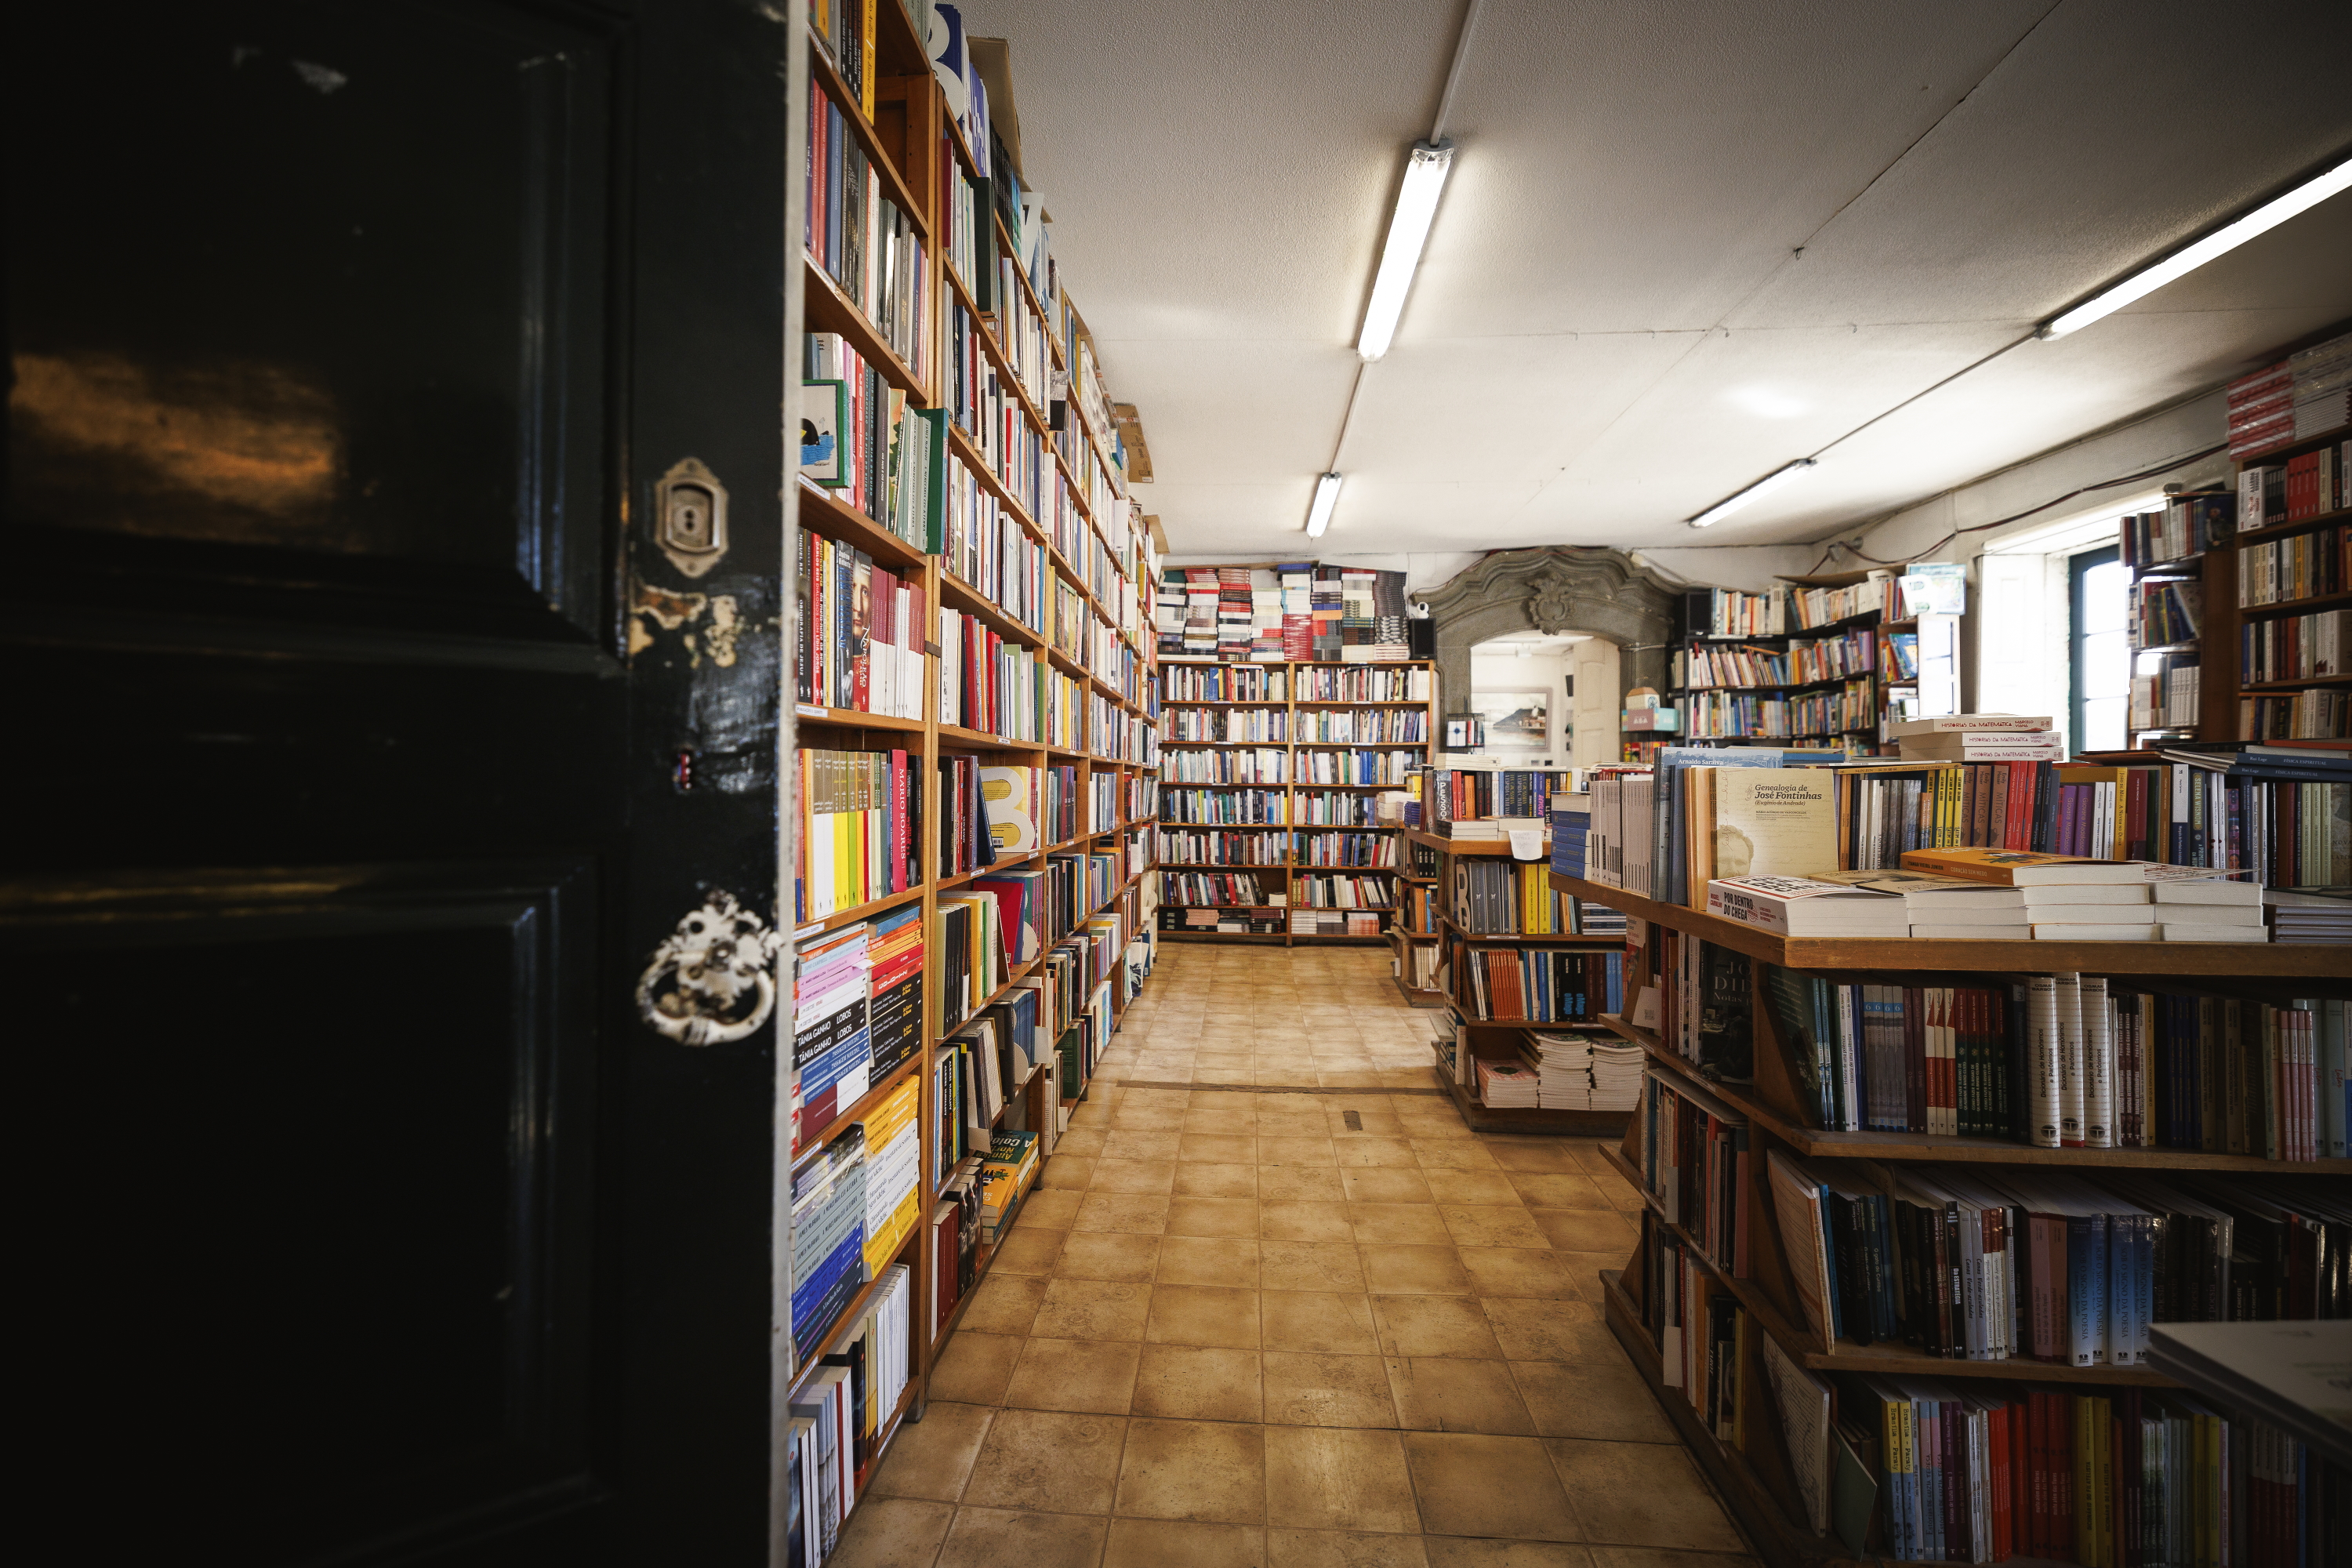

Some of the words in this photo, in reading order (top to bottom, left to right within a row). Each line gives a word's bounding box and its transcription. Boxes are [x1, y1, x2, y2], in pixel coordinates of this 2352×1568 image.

[1755, 784, 1797, 793] Genealogia
[1755, 791, 1774, 800] José
[1775, 791, 1822, 800] Fontinhas
[1724, 891, 1734, 905] POR
[1734, 895, 1753, 909] DENTRO
[1723, 904, 1731, 915] DO
[1731, 907, 1748, 921] CHEGA
[1714, 992, 1742, 1004] Notas
[812, 1021, 831, 1038] GANHO
[837, 1009, 851, 1024] LOBOS
[813, 1036, 832, 1054] GANHO
[837, 1024, 852, 1040] LOBOS
[992, 1138, 1021, 1146] Coló
[798, 1227, 808, 1240] JAMES
[2081, 1300, 2088, 1311] DA
[2122, 1298, 2128, 1309] DA
